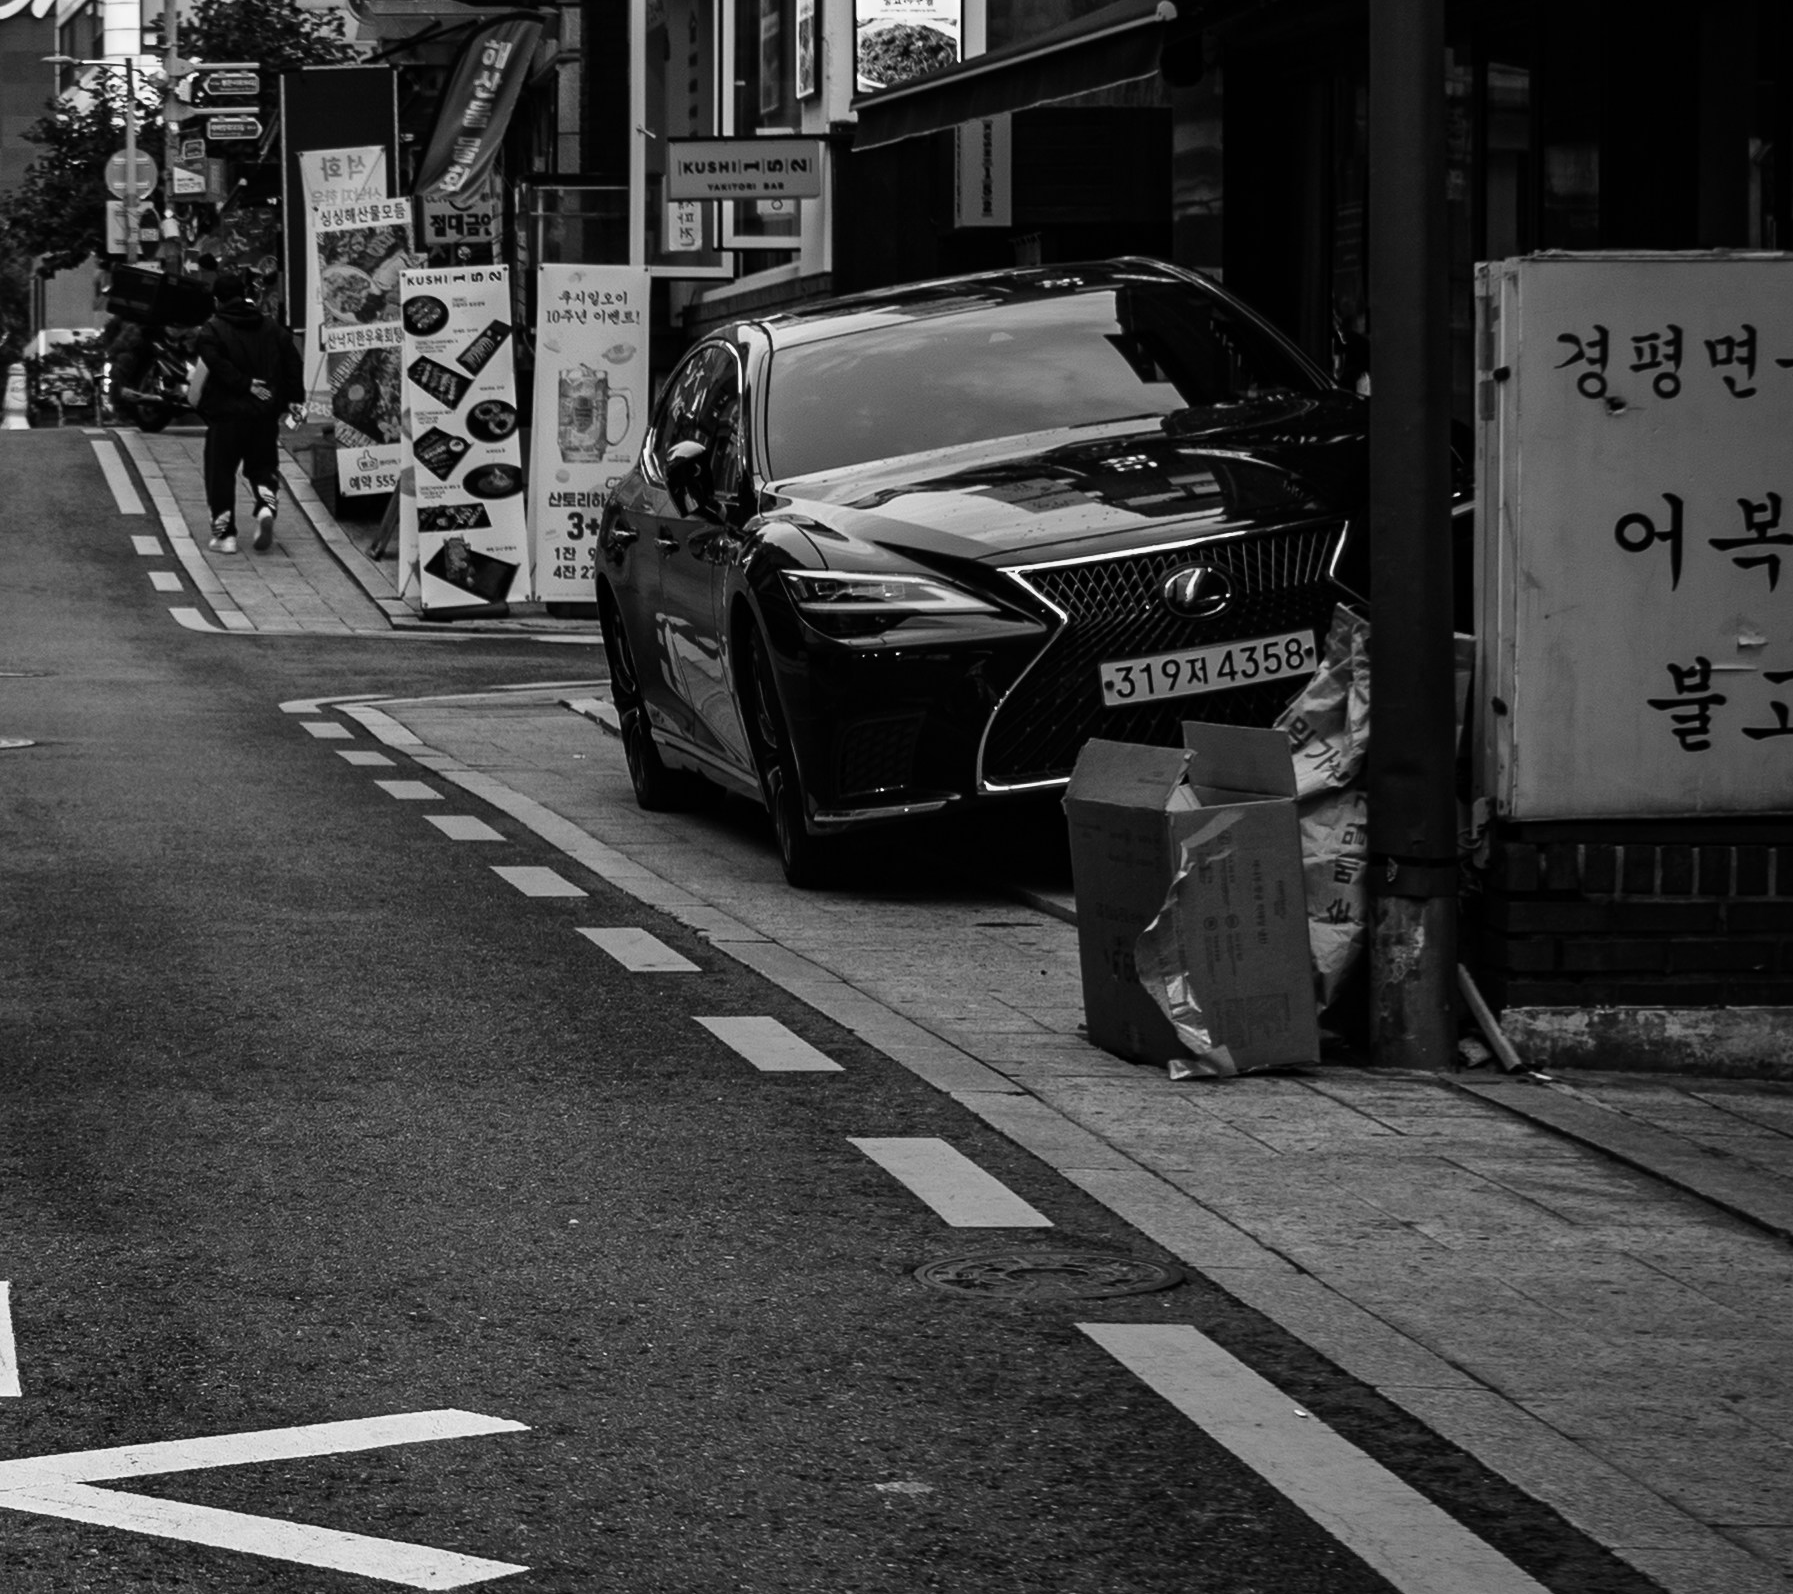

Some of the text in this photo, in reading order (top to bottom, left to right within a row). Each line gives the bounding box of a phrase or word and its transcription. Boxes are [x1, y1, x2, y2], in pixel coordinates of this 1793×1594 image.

[683, 161, 737, 174] KUSHI
[707, 182, 785, 191] YAKITORI BAR
[407, 276, 448, 286] KUSHI
[546, 309, 641, 325] 10주년 이벤트!
[1554, 324, 1793, 399] 경평면
[349, 474, 373, 491] 예약
[1614, 491, 1793, 593] 어복
[554, 546, 577, 562] 1잔
[553, 565, 577, 580] 4잔
[1114, 637, 1305, 699] 319저 4358
